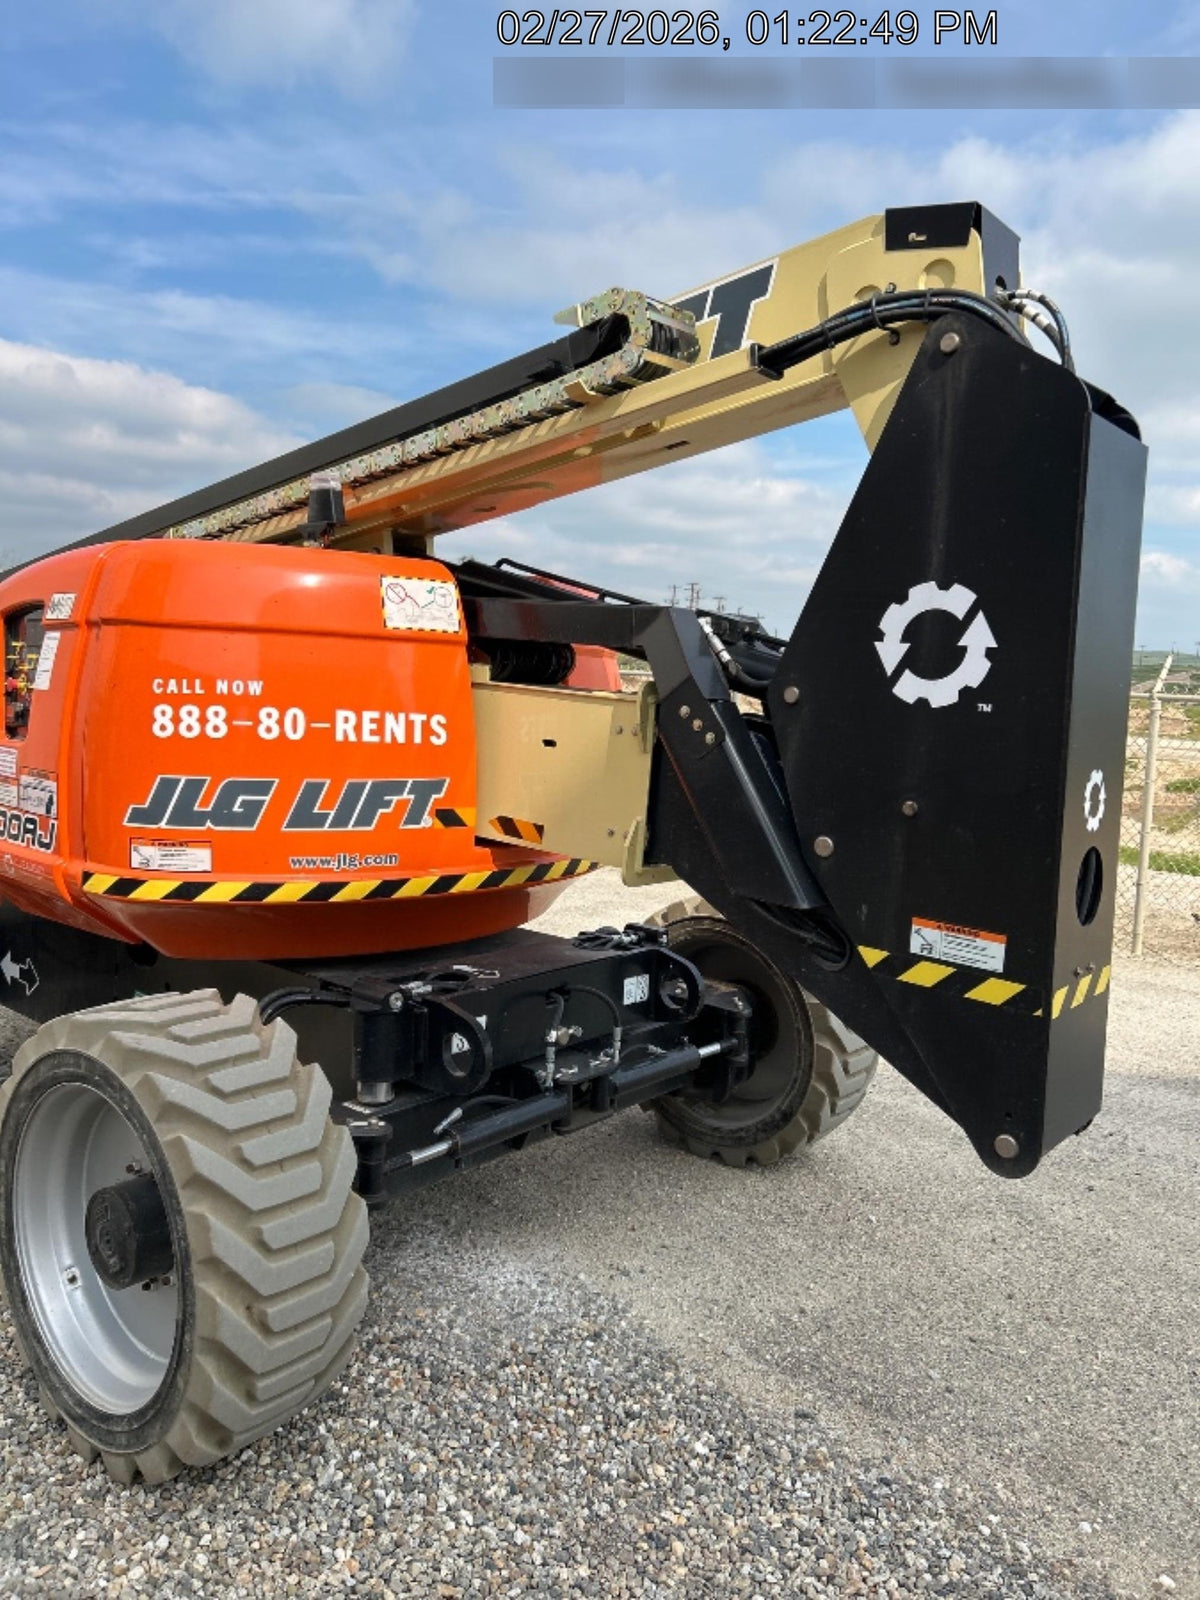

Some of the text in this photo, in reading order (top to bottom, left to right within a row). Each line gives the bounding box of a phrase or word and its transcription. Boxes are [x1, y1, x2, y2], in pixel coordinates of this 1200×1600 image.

[152, 678, 264, 696] CALL NOW
[152, 703, 448, 746] 888-80-RENTS
[122, 774, 279, 831] JLG
[288, 853, 399, 872] www.jlg.com
